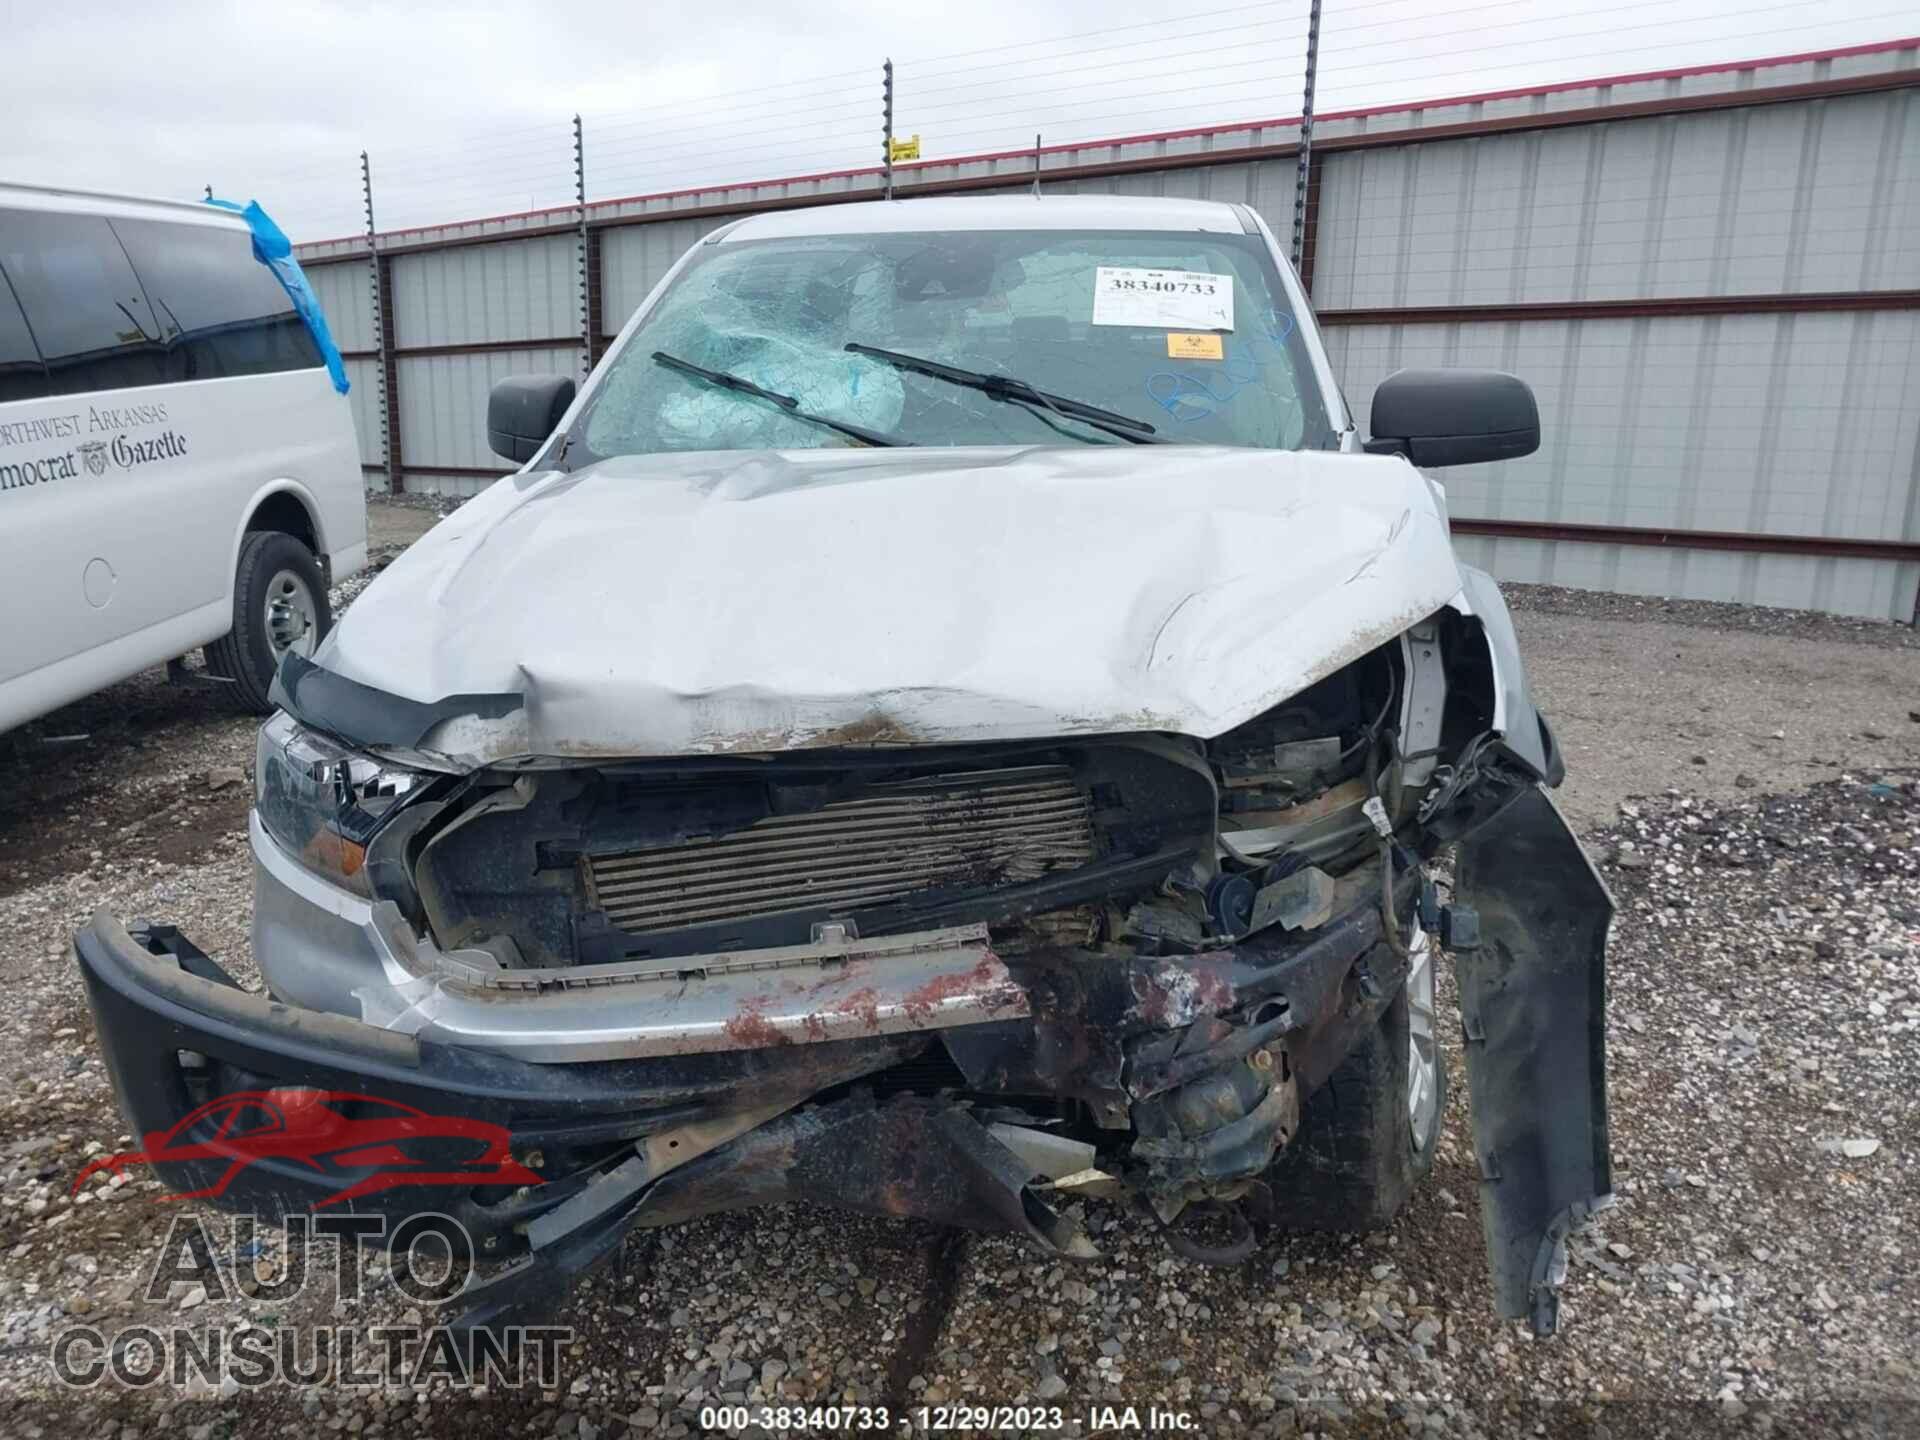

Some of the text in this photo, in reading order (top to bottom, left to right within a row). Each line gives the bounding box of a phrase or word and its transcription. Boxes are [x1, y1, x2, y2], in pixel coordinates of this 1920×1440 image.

[1110, 279, 1216, 295] 38340733
[0, 404, 168, 446] RTHWEST ARKANSAS
[111, 430, 187, 469] Gazette
